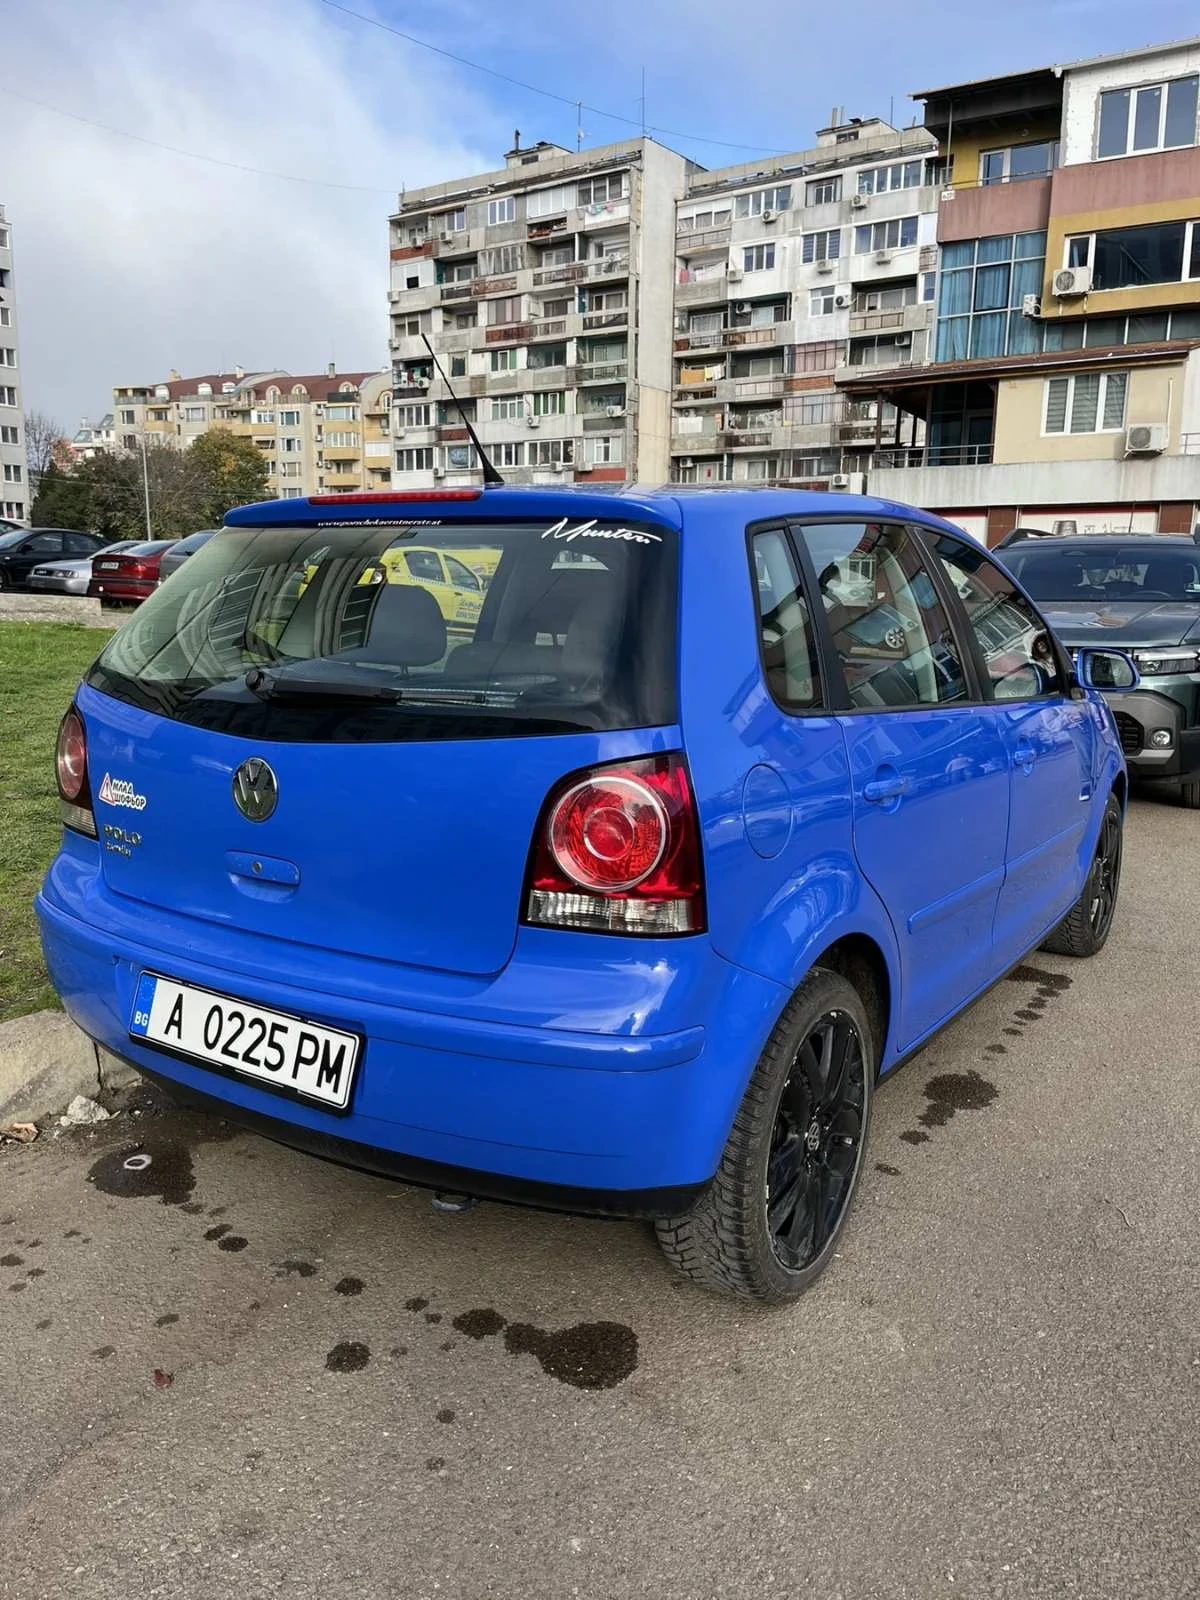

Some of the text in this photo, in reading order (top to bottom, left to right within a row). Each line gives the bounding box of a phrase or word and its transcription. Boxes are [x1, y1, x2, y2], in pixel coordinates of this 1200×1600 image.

[112, 780, 132, 795] МЛАД
[112, 792, 146, 808] ШОФЬОР
[104, 824, 142, 844] POLO
[134, 1010, 149, 1027] BG
[164, 993, 184, 1040] A
